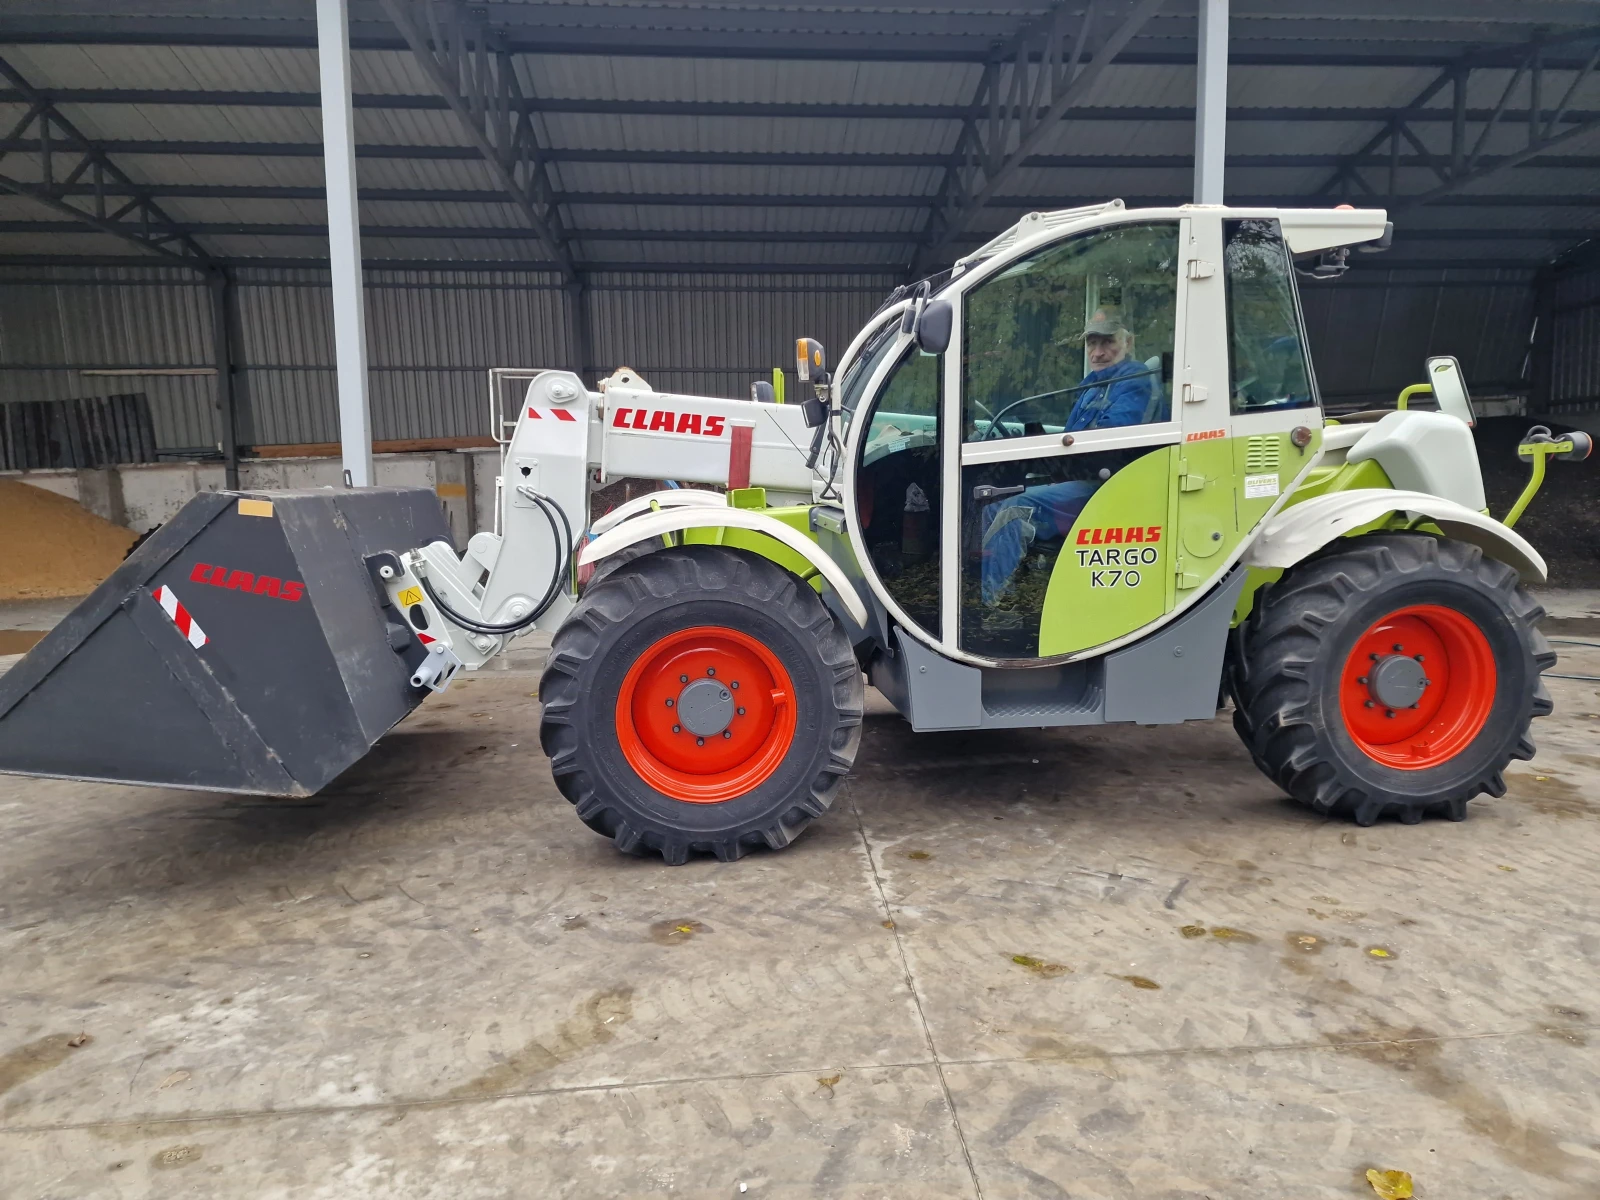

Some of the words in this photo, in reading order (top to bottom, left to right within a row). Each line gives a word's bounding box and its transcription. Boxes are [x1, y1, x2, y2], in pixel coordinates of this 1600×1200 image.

[613, 407, 726, 437] CLAAS
[1186, 429, 1226, 442] CLAAS
[1076, 526, 1162, 545] CLAAS
[1075, 547, 1158, 567] TARGO
[189, 562, 305, 602] CLAAS
[1091, 570, 1141, 588] K70
